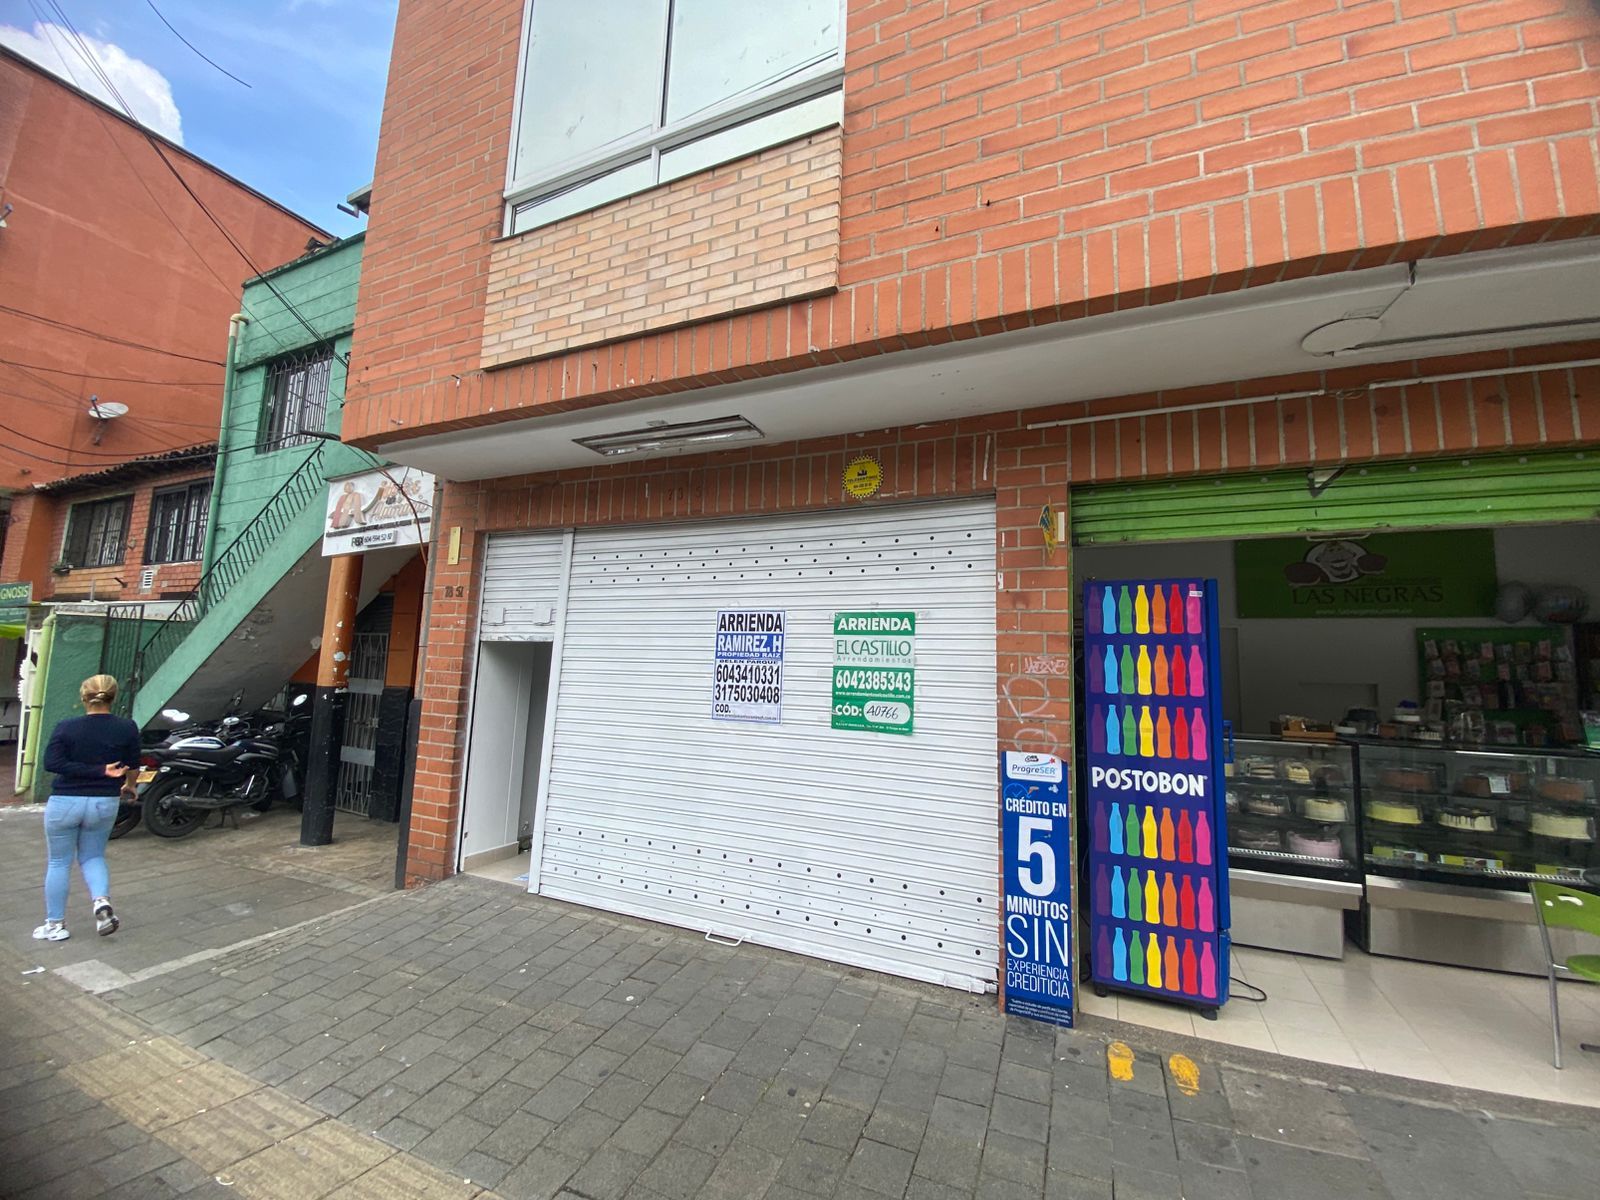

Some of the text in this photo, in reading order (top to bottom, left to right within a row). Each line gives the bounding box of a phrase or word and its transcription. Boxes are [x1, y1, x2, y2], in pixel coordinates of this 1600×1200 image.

[1292, 585, 1444, 605] LAS NEGRAS
[718, 613, 783, 632] ARRIENDA
[837, 617, 912, 631] ARRIENDA
[717, 634, 782, 653] RAMIREZ. H
[836, 639, 912, 656] EL CASTILLO
[836, 655, 912, 664] Arrendamientos
[716, 664, 780, 685] 6043410331
[835, 669, 911, 692] 6042385343
[714, 683, 780, 704] 3175030408
[714, 703, 731, 713] COD.
[835, 702, 862, 717] CÓD:
[1012, 764, 1056, 775] ProgreSER
[1091, 766, 1204, 797] POSTOBON
[1005, 796, 1067, 818] CRÉDITO EN
[1017, 815, 1056, 897] 5
[1006, 894, 1069, 921] MINUTOS
[1007, 914, 1069, 967] SIN
[1006, 958, 1070, 982] EXPERIENCIA
[1007, 971, 1070, 999] CREDITICIA
